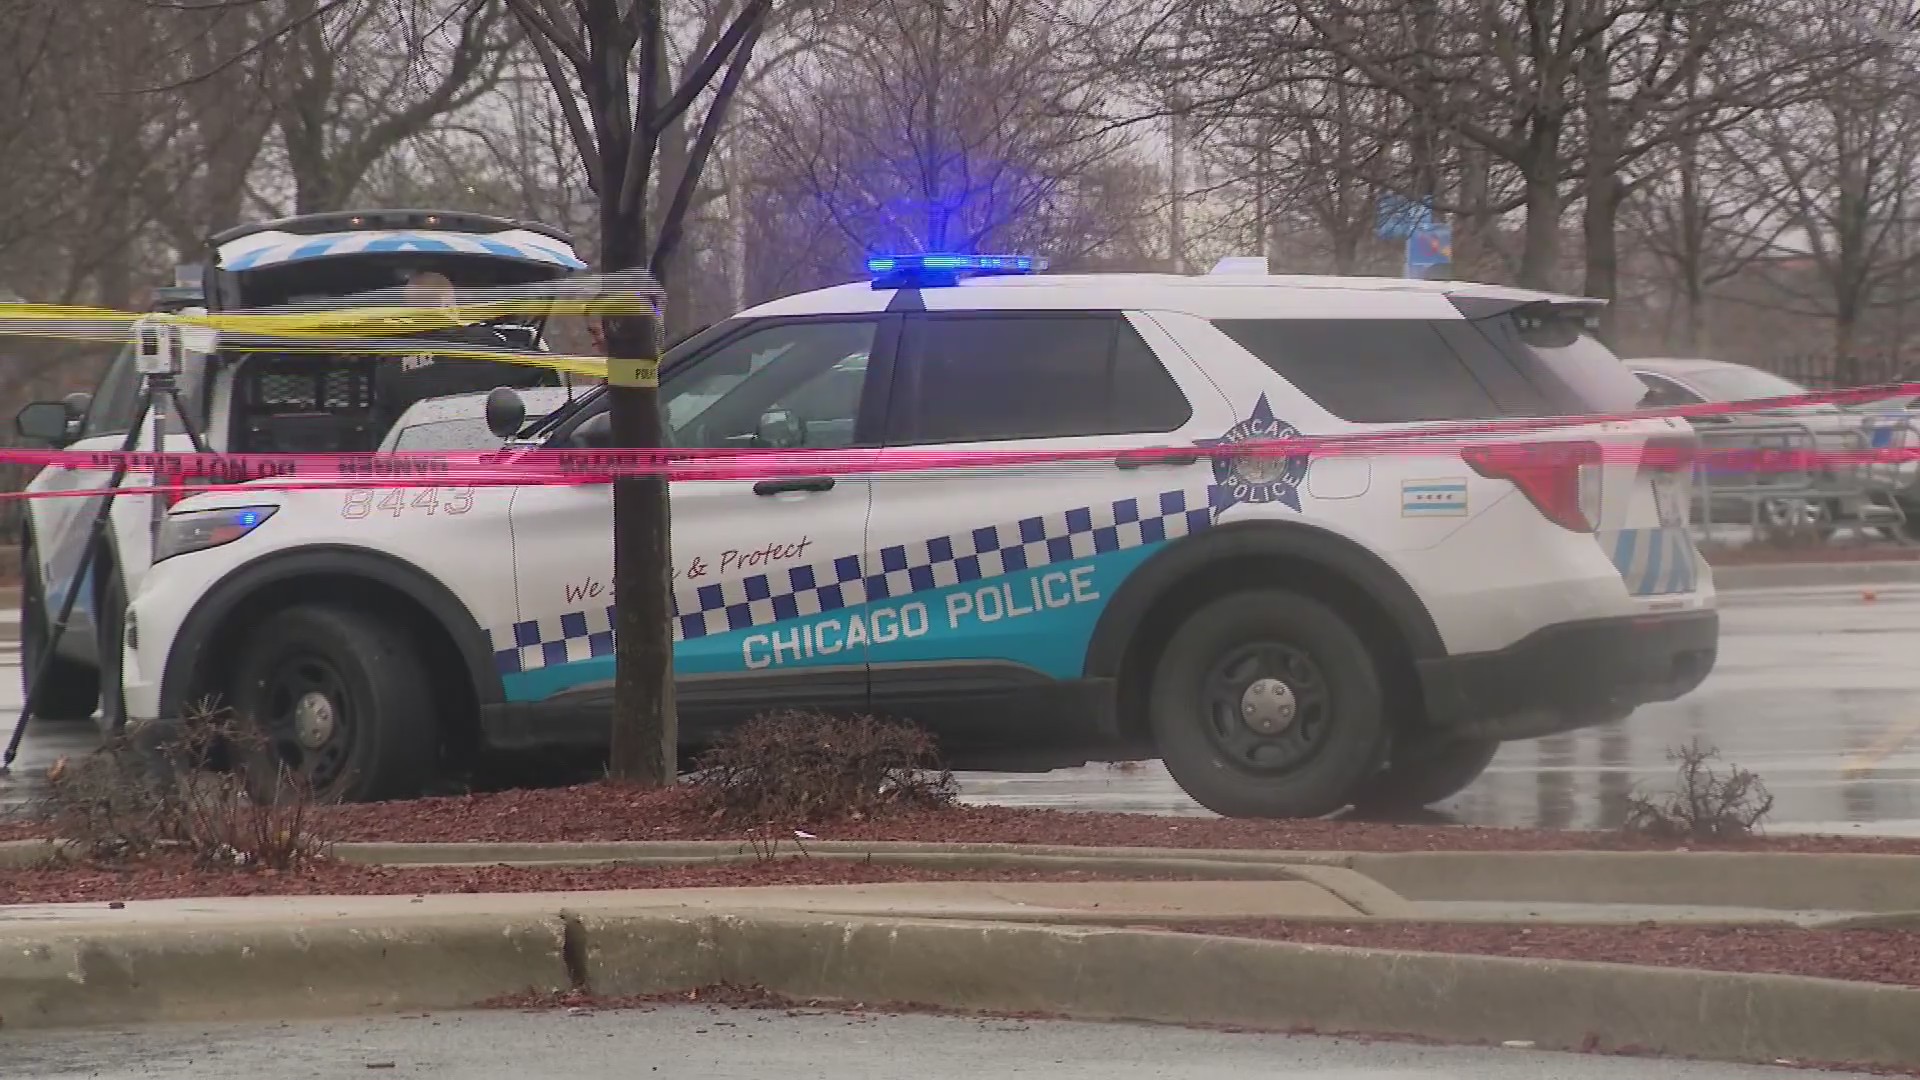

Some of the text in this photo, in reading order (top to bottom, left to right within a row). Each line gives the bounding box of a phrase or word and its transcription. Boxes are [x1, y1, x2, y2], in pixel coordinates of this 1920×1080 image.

[341, 486, 475, 520] 8443
[1221, 472, 1301, 502] POLICE
[564, 576, 604, 604] We
[687, 556, 709, 580] &
[719, 535, 813, 574] Protect
[742, 565, 1100, 670] CHICAGO POLICE
